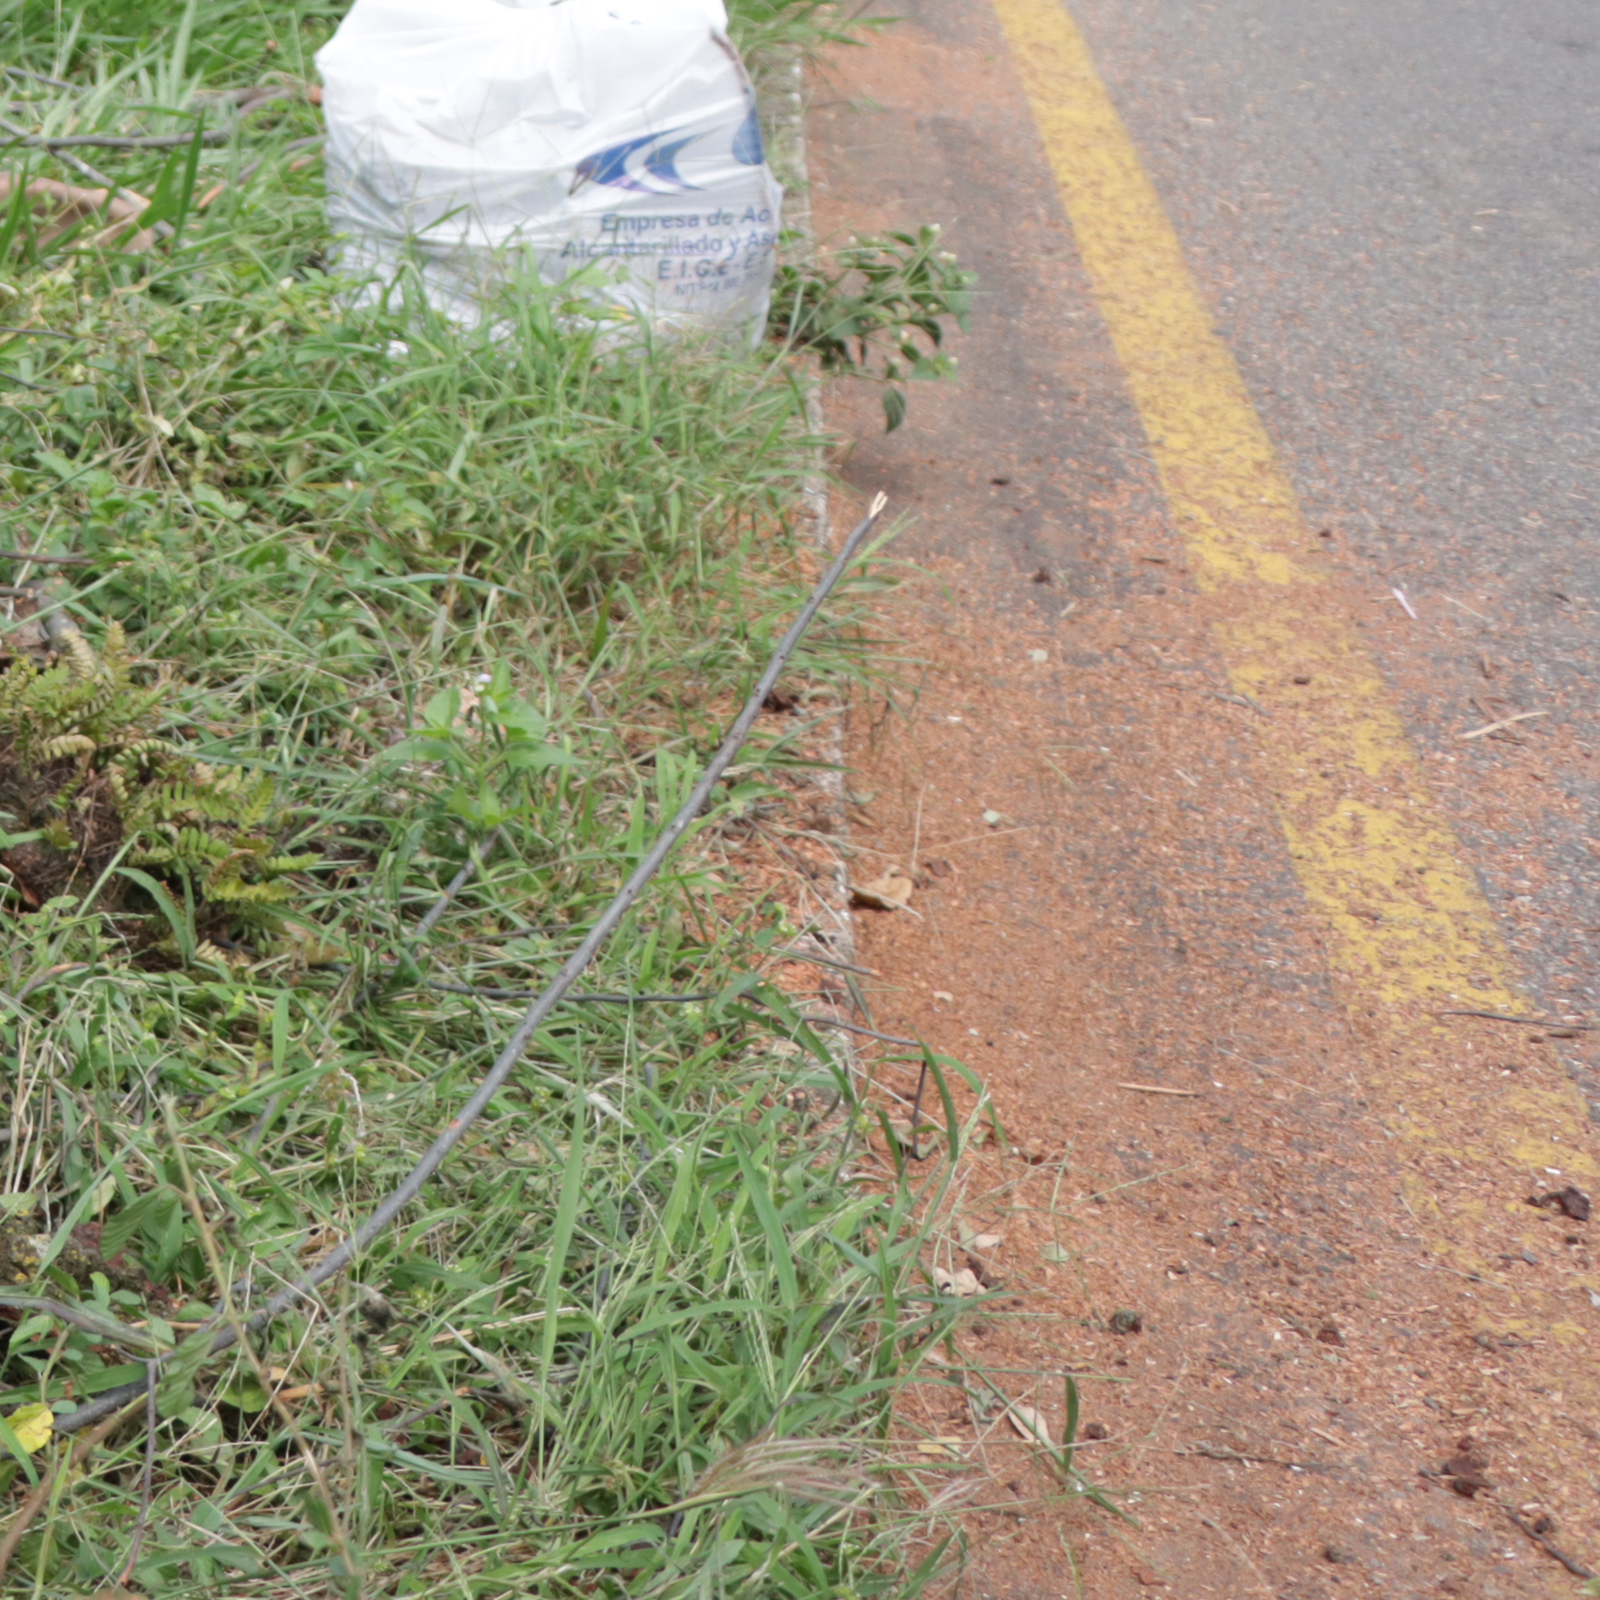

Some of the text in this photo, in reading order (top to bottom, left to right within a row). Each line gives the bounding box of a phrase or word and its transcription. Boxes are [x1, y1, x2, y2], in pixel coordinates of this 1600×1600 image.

[601, 212, 700, 234] Empresa
[707, 208, 733, 226] de
[560, 233, 723, 259] Alcantarillado
[728, 236, 742, 262] y
